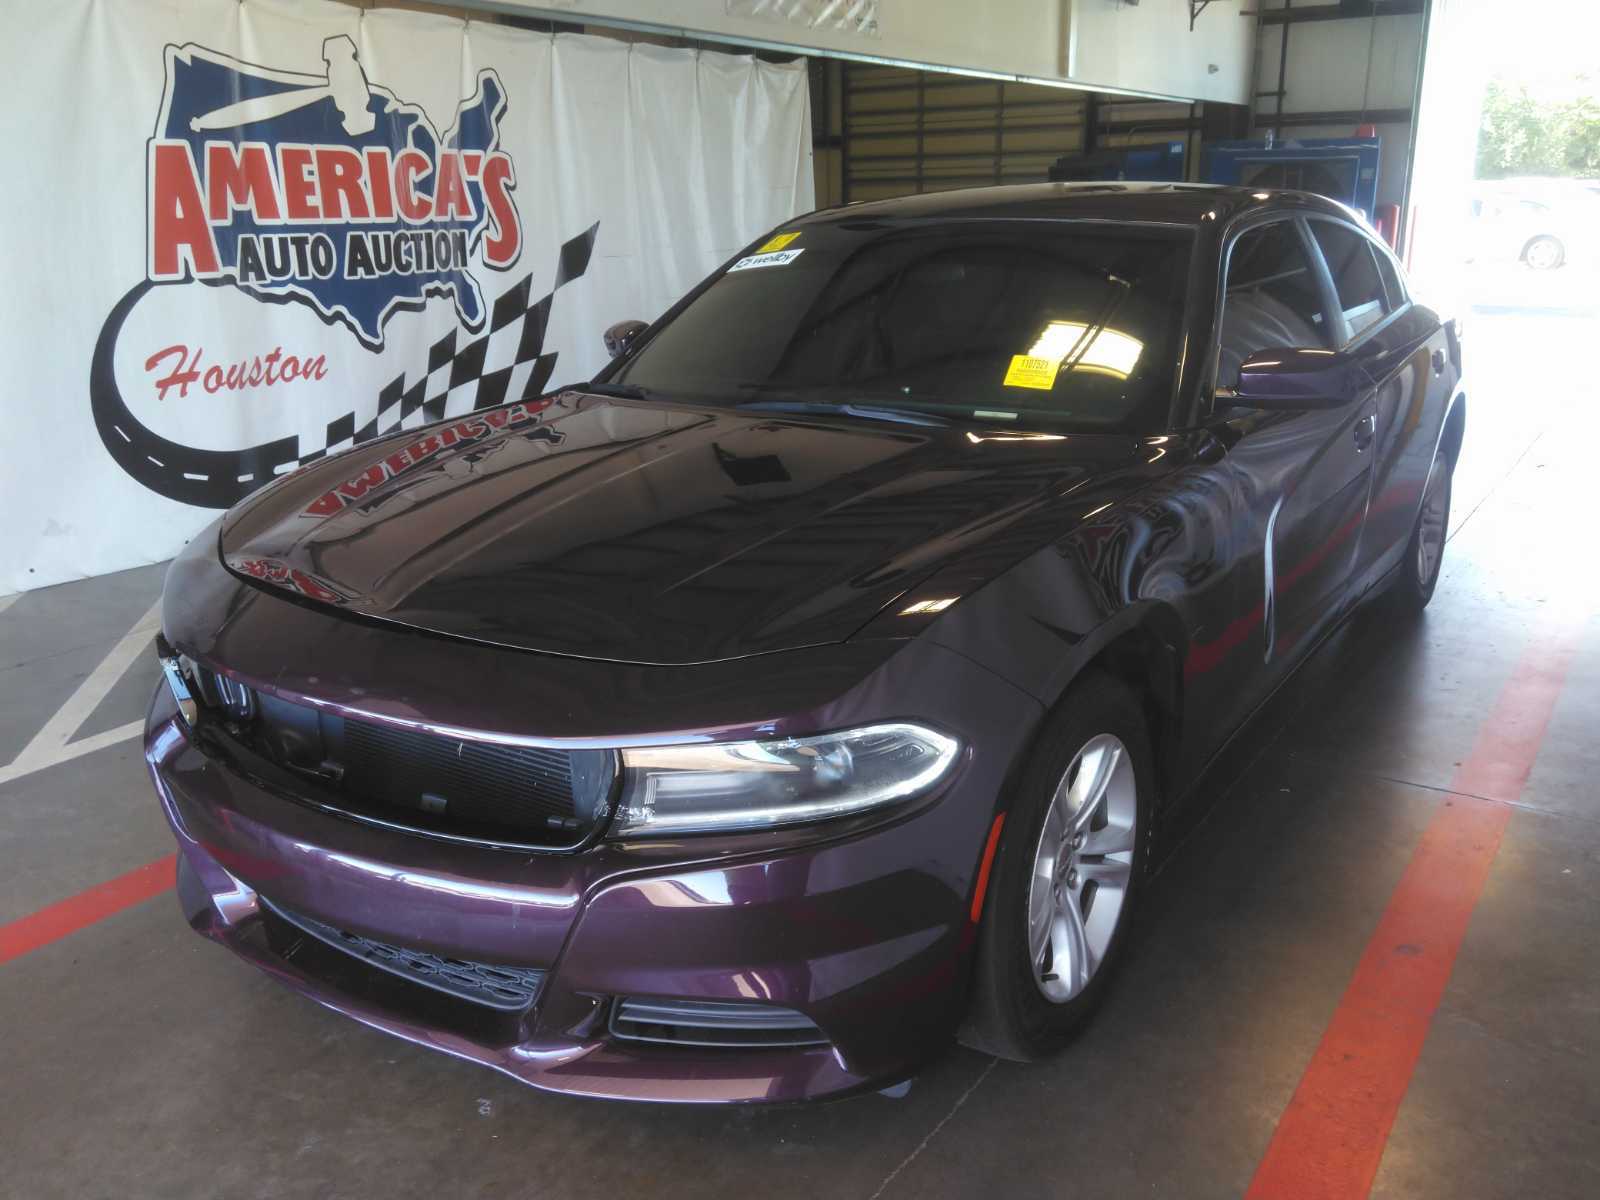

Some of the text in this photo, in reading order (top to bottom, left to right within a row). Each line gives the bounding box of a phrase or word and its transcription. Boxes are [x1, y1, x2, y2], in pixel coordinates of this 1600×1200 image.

[153, 144, 519, 275] AMERICA'S
[240, 230, 469, 282] AUTO AUCTION
[144, 344, 329, 401] Houston
